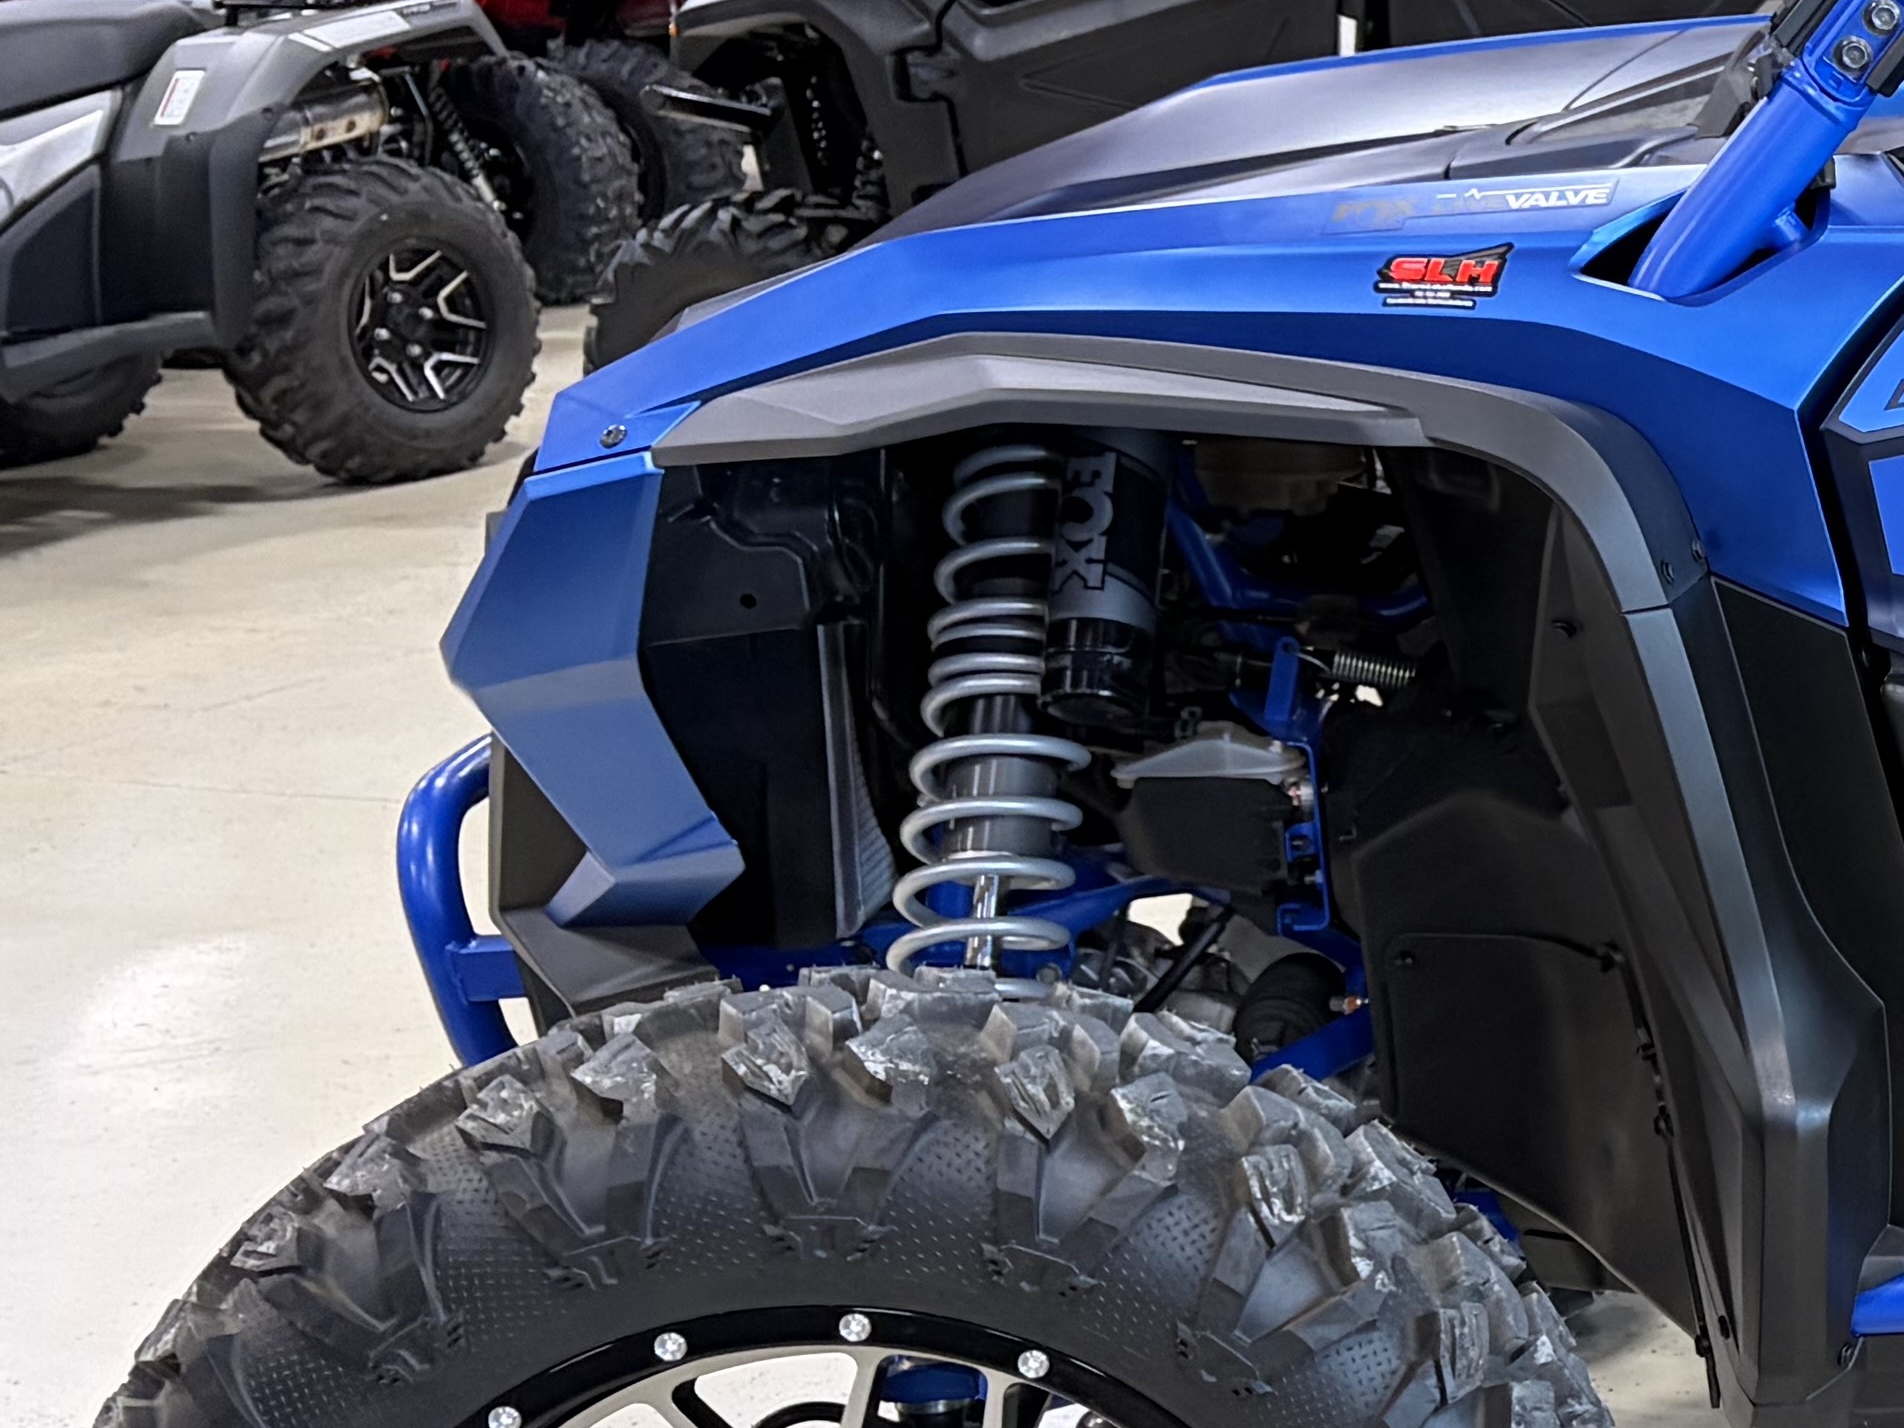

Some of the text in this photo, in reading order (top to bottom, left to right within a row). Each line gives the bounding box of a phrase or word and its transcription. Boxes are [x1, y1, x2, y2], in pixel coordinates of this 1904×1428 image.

[1506, 188, 1611, 210] VALVE
[1388, 257, 1500, 284] SLH
[1053, 452, 1118, 593] FOX
